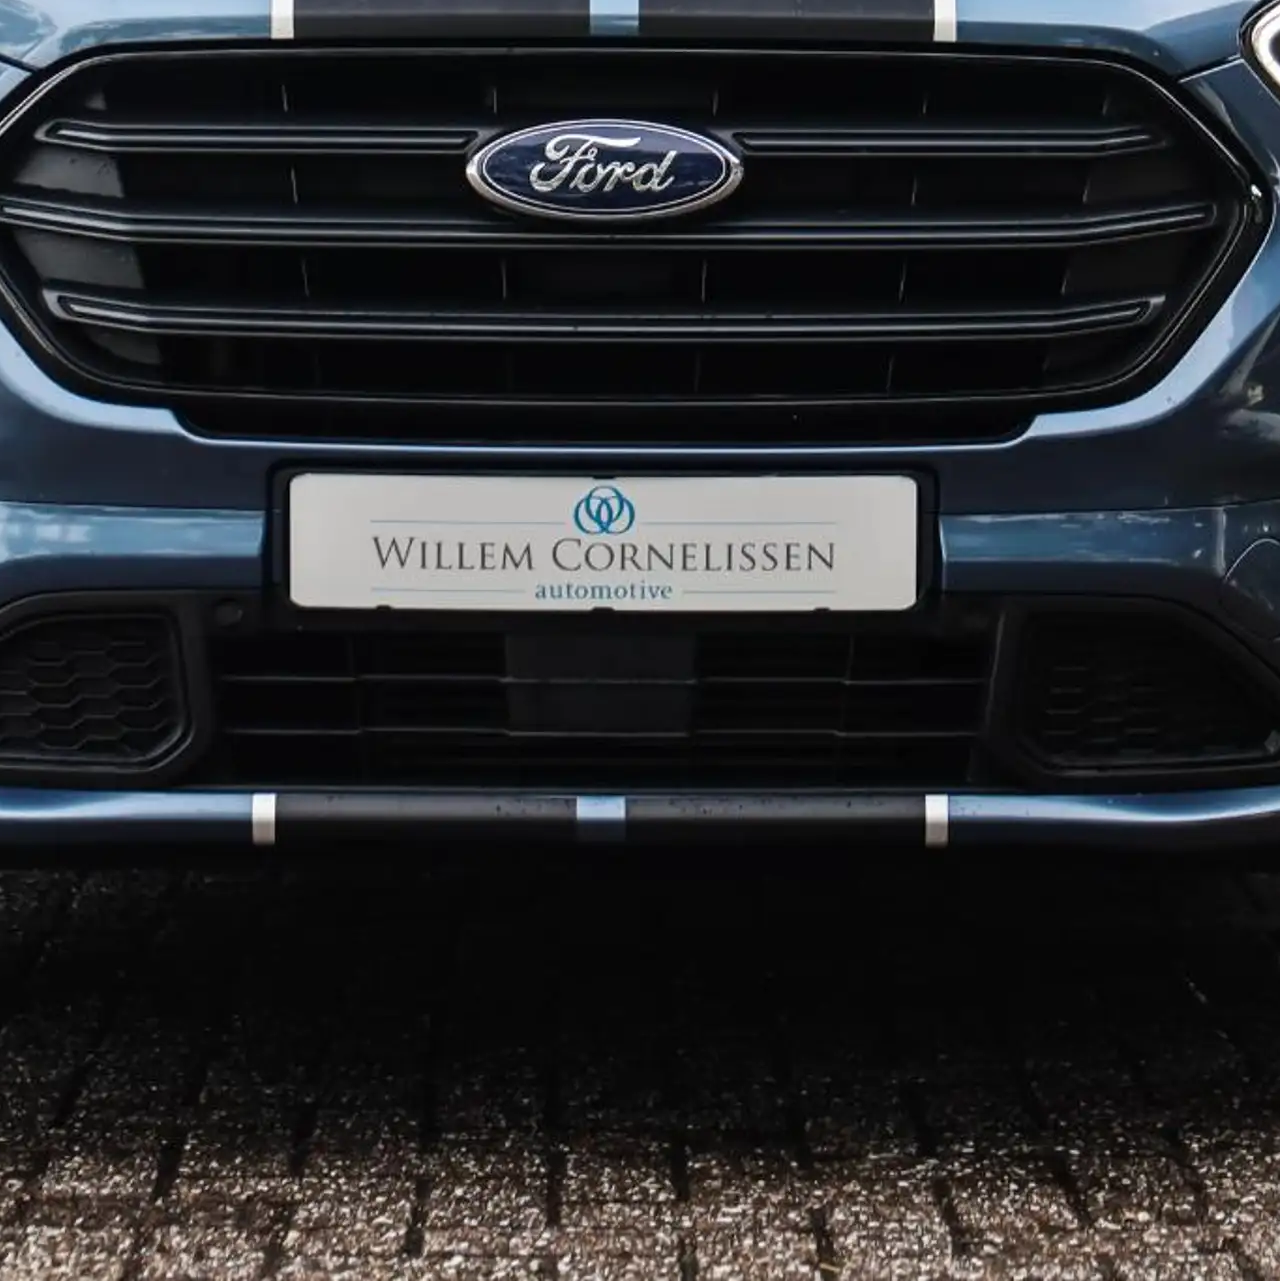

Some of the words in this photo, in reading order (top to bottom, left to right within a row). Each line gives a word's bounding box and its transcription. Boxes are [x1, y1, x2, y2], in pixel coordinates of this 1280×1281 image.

[529, 133, 678, 193] Ford
[372, 536, 535, 571] WILLEM
[551, 537, 836, 572] CORNELISSEN
[534, 580, 674, 600] automotive
